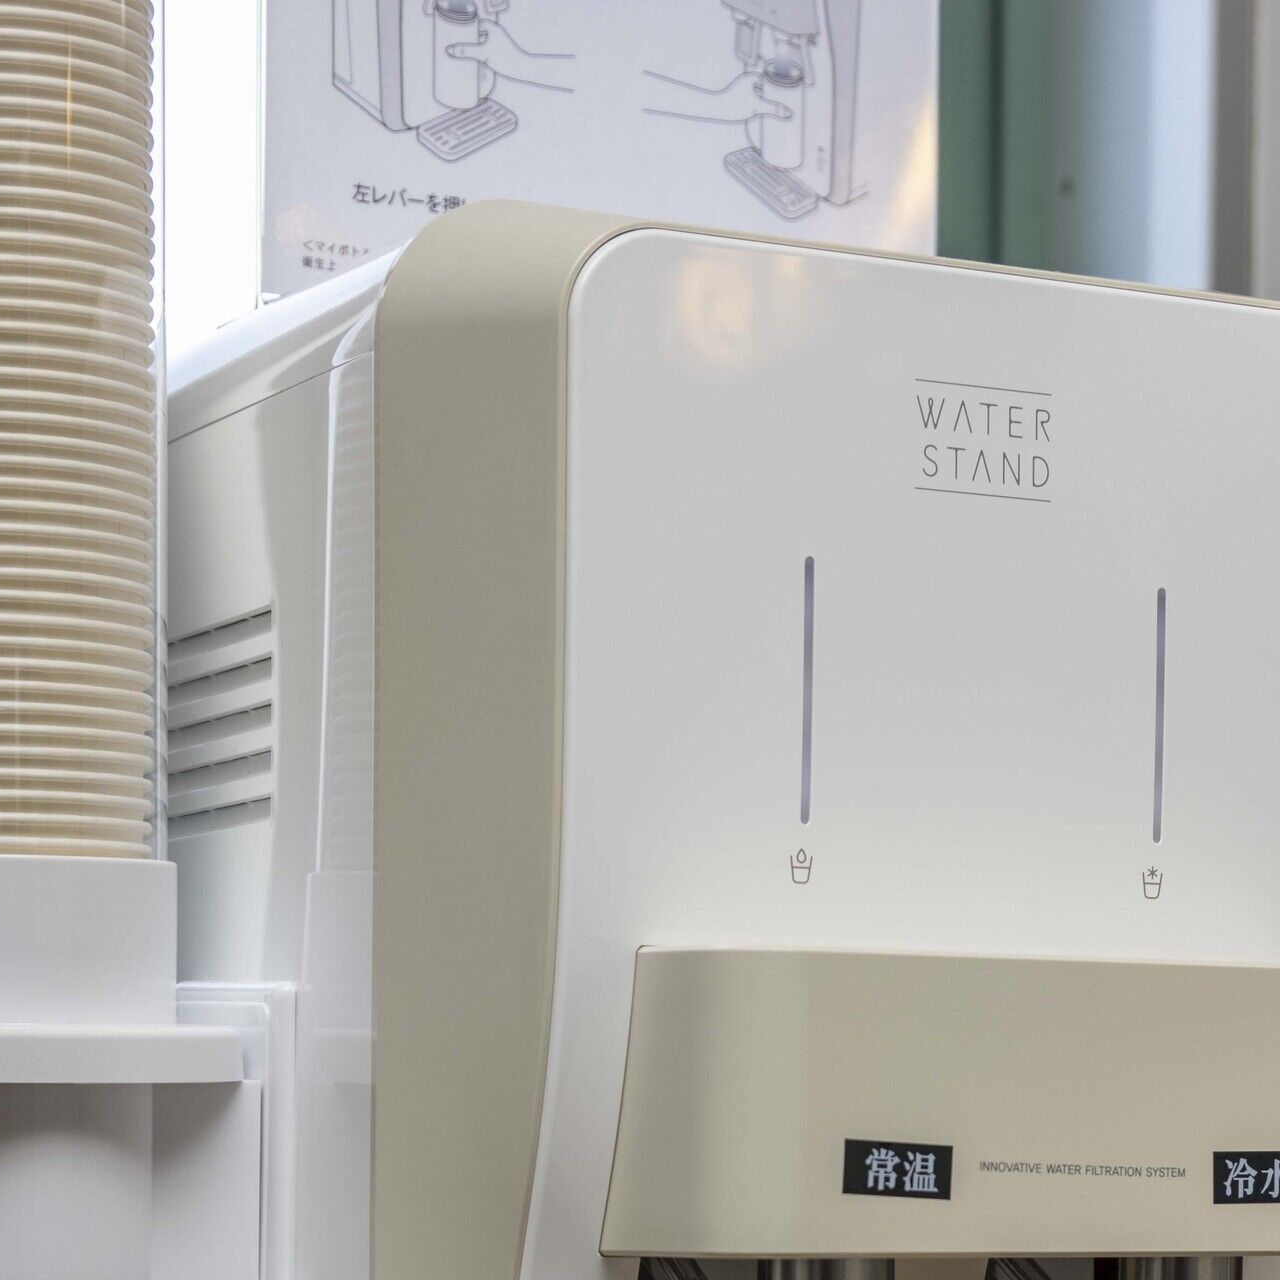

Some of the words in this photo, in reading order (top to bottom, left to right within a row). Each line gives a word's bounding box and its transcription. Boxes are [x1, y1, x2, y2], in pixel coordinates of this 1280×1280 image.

[916, 394, 1051, 442] WATER
[923, 444, 1050, 488] STAND
[864, 1147, 939, 1193] 常温
[979, 1161, 1042, 1174] INNOVATIVE
[1046, 1163, 1081, 1175] WATER
[1085, 1165, 1142, 1177] FILTRATION
[1146, 1166, 1186, 1178] SYSTEM
